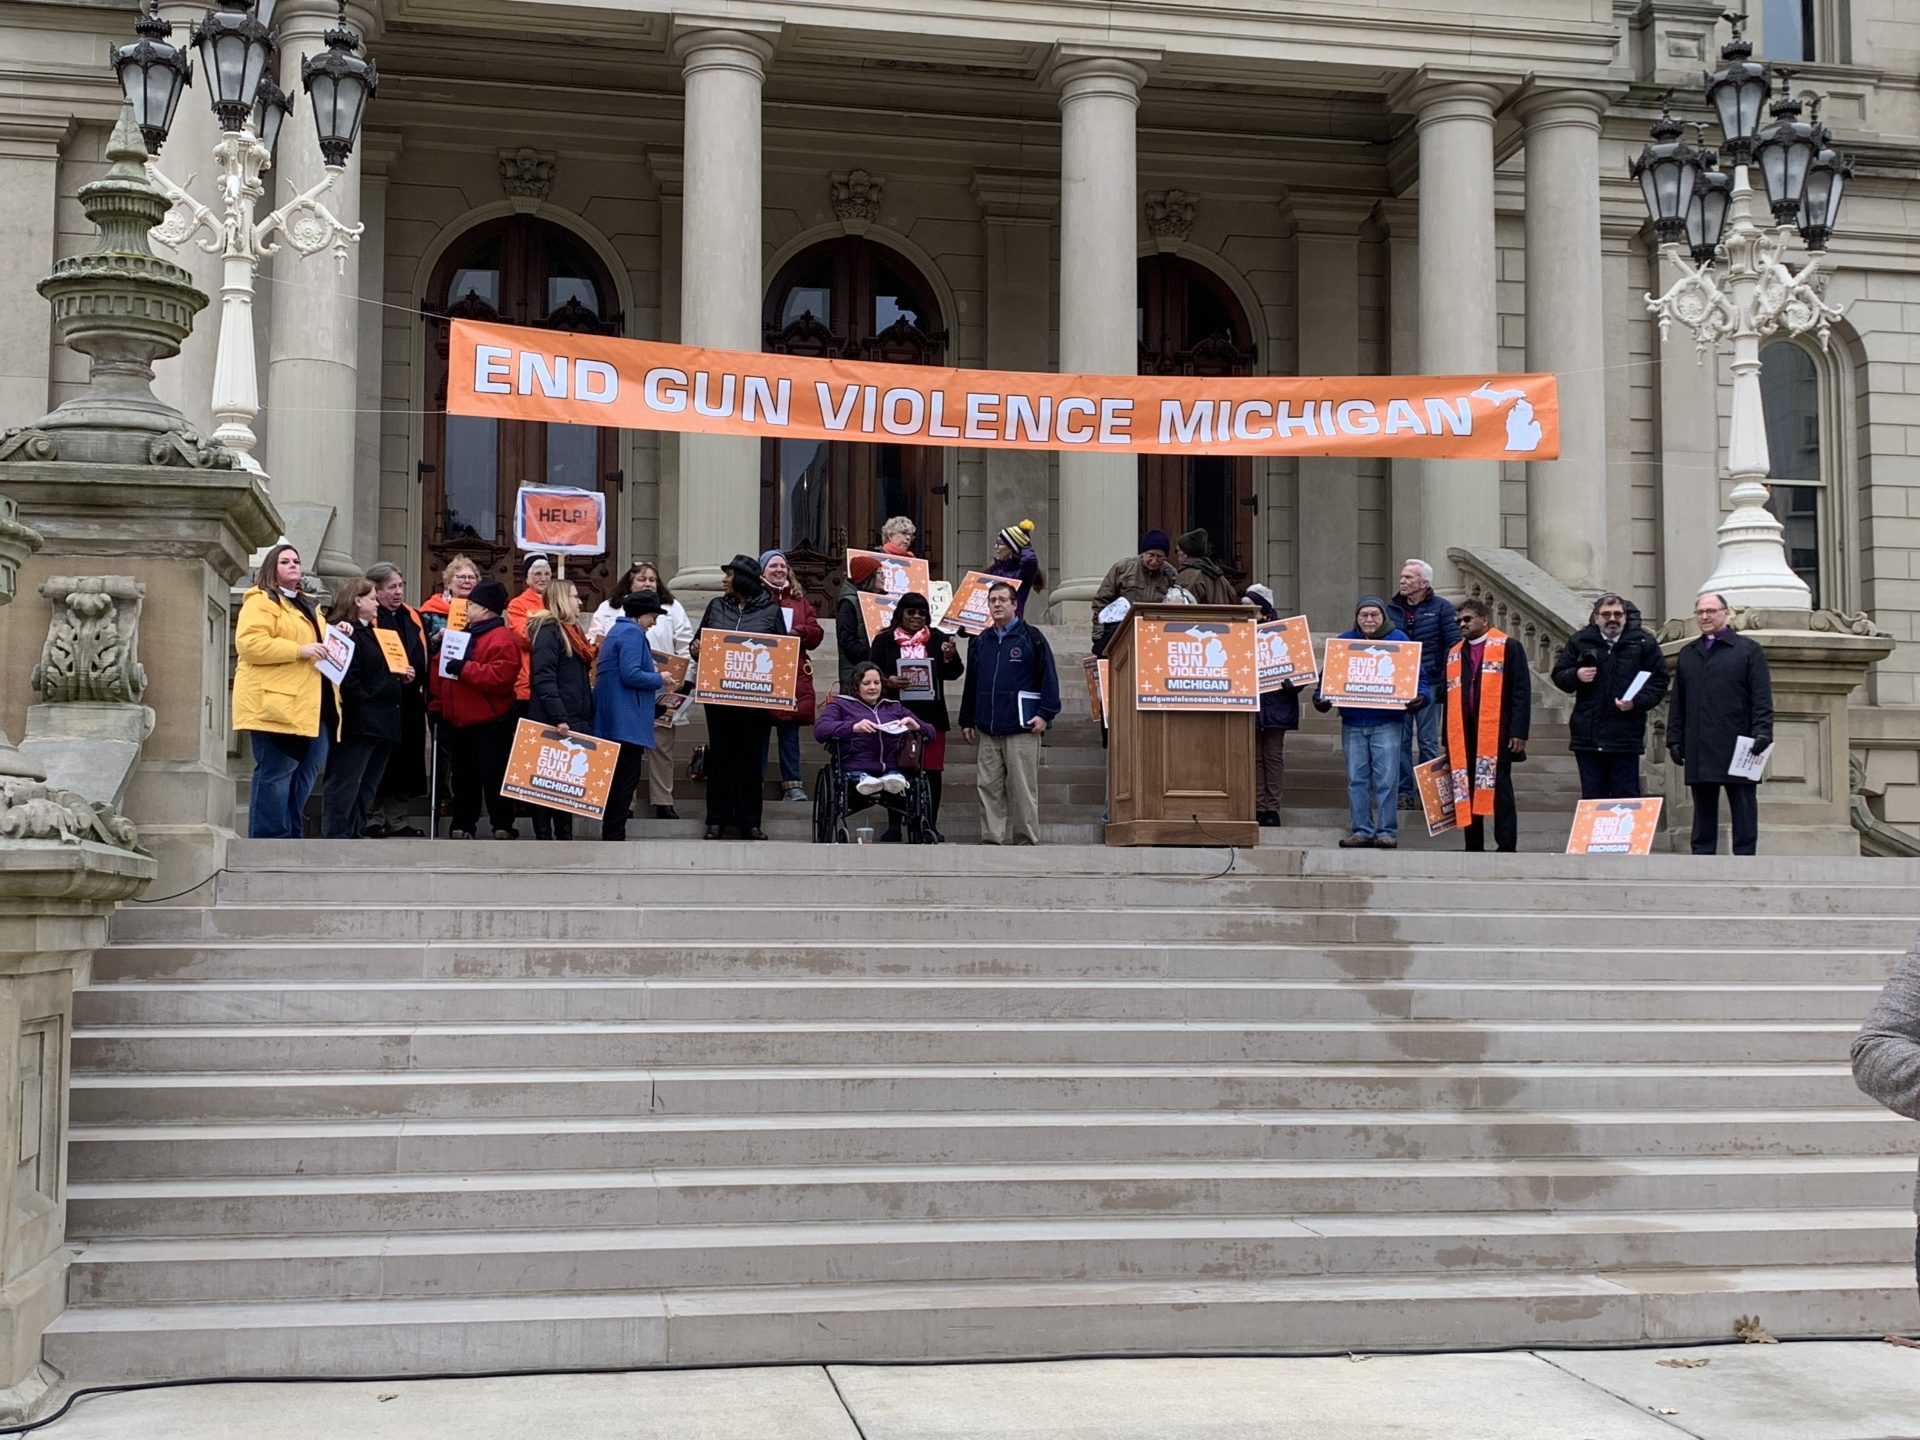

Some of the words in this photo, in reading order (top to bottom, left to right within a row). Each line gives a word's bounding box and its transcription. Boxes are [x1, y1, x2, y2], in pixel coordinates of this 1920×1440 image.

[474, 344, 619, 404] END
[643, 368, 792, 426] GUN
[815, 381, 1134, 445] VIOLENCE
[1158, 396, 1473, 445] MICHIGAN
[538, 507, 588, 523] HELP!
[1167, 641, 1203, 655] END
[725, 650, 754, 662] END
[1167, 654, 1203, 667] GUN
[1349, 657, 1377, 667] END
[724, 660, 753, 672] GUN
[1168, 666, 1228, 678] VIOLENCE
[1348, 666, 1376, 676] GUN
[724, 670, 773, 682] VIOLENCE
[1347, 675, 1394, 685] VIOLENCE
[722, 680, 772, 692] MICHIGAN
[1168, 679, 1229, 690] MICHIGAN
[1345, 684, 1393, 694] MICHIGAN
[1142, 696, 1253, 705] endgunviolencemichigan.org
[539, 745, 571, 762] END
[537, 756, 568, 773] GUN
[536, 766, 587, 786] VIOLENCE
[531, 776, 584, 797] MICHIGAN
[507, 785, 600, 813] endgunviolencemichigan.org
